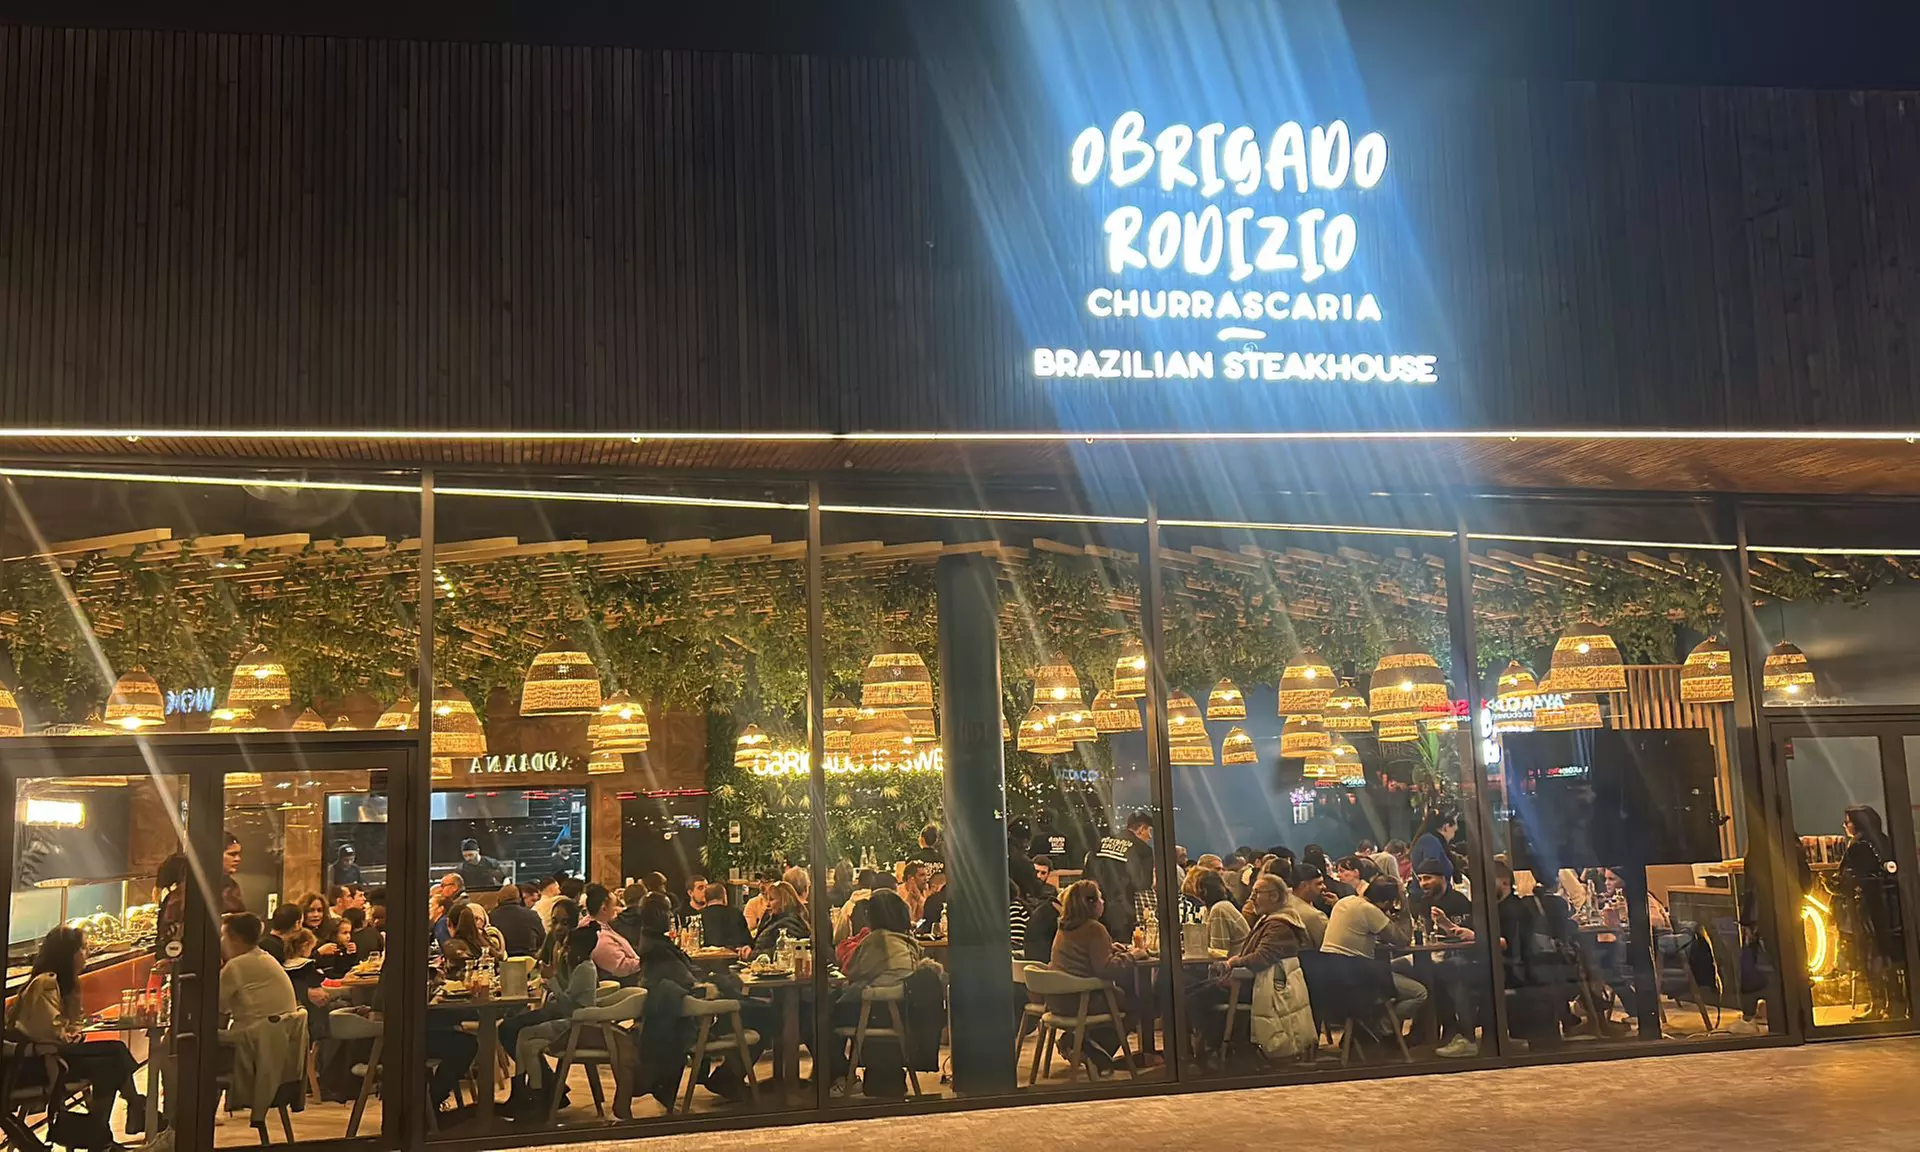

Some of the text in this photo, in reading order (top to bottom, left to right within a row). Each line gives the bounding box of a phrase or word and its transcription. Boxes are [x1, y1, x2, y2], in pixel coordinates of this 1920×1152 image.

[1071, 109, 1388, 198] OBRIGADO
[1103, 203, 1357, 282] RODIZIO
[1087, 288, 1382, 321] CHURRASCARIA
[1034, 348, 1438, 383] BRAZILIAN STEAKHOUSE
